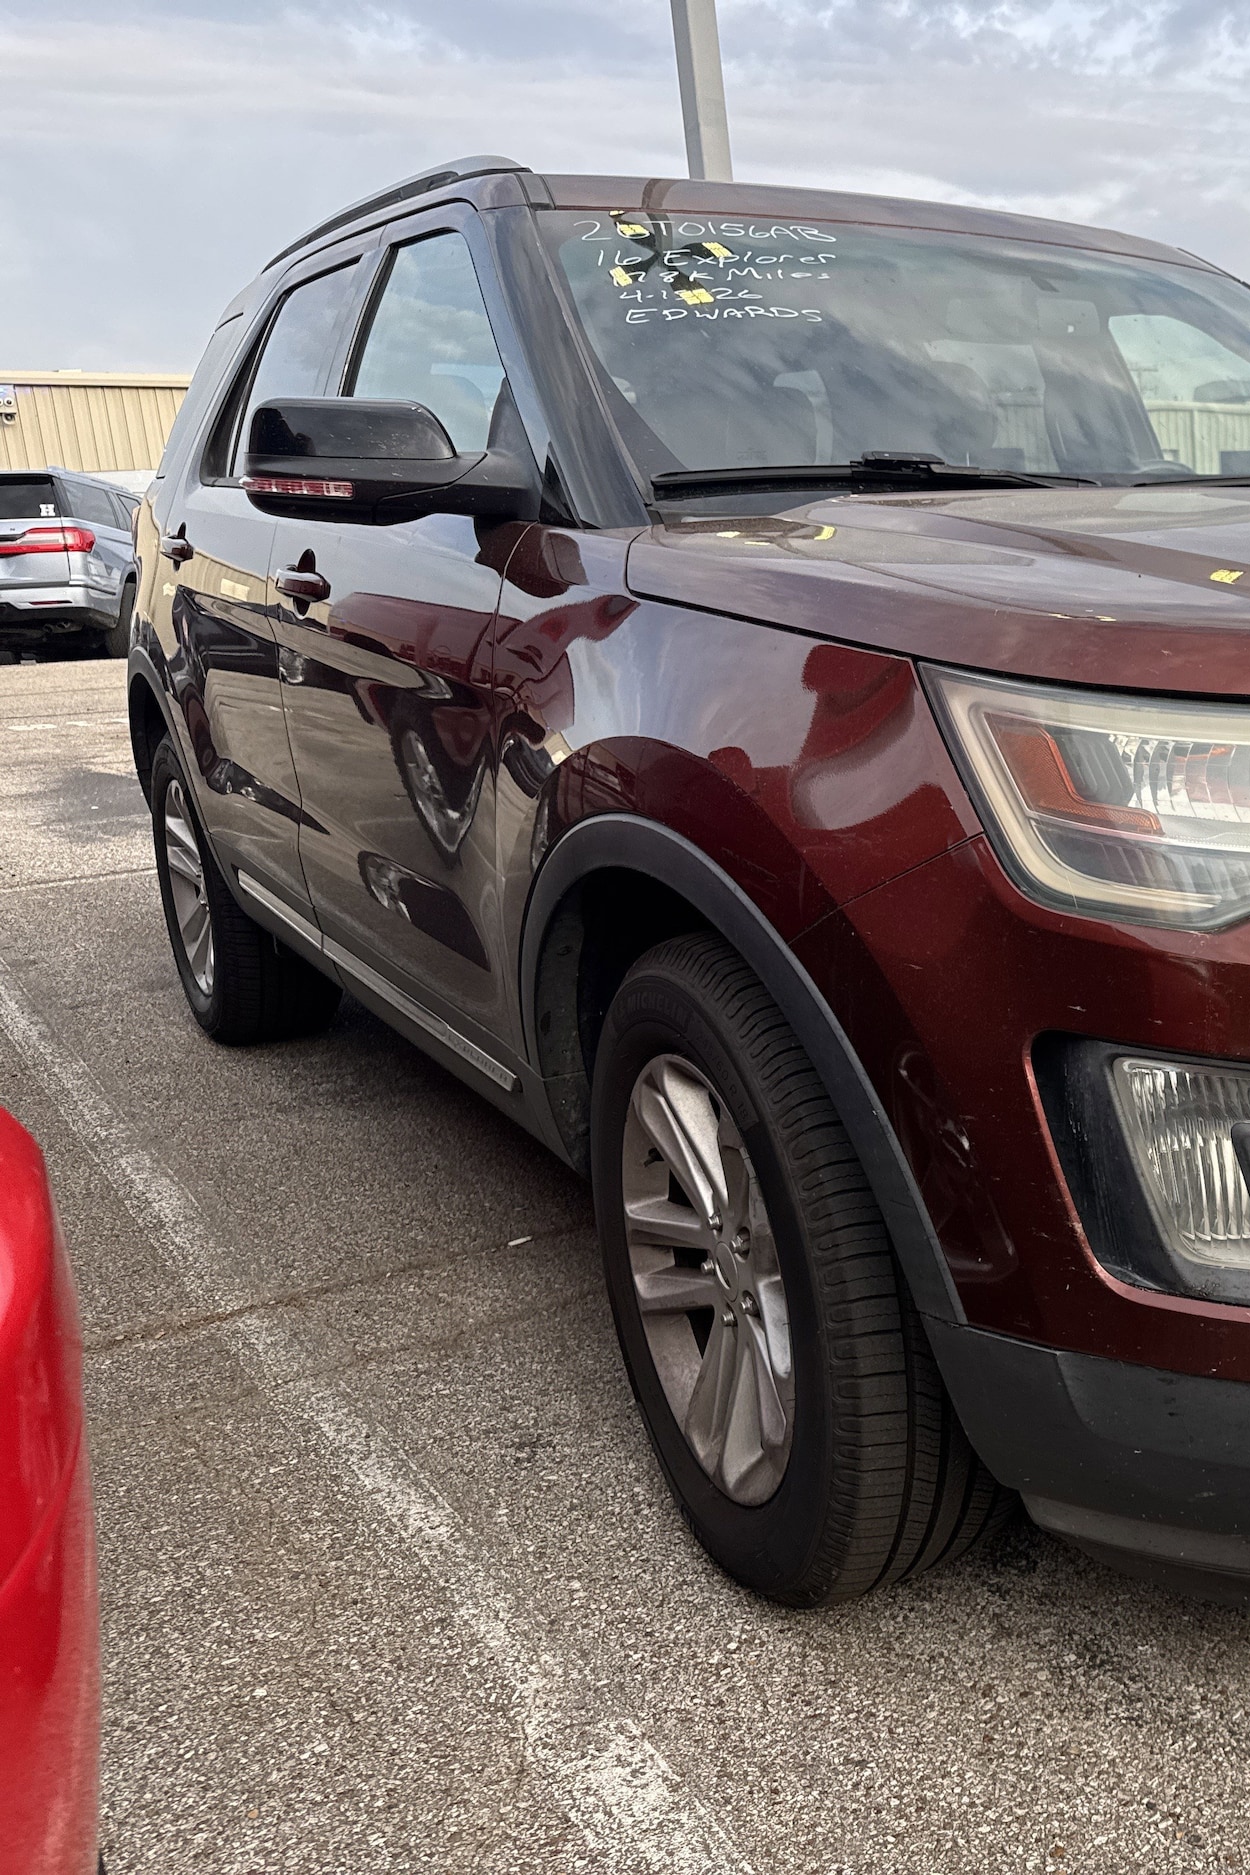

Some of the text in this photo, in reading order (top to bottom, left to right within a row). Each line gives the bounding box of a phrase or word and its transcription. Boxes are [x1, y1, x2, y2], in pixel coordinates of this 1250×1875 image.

[597, 248, 836, 268] 16 Explorer
[726, 266, 830, 281] Miles
[625, 306, 822, 324] EDWARDS
[626, 991, 688, 1029] MICHELIN
